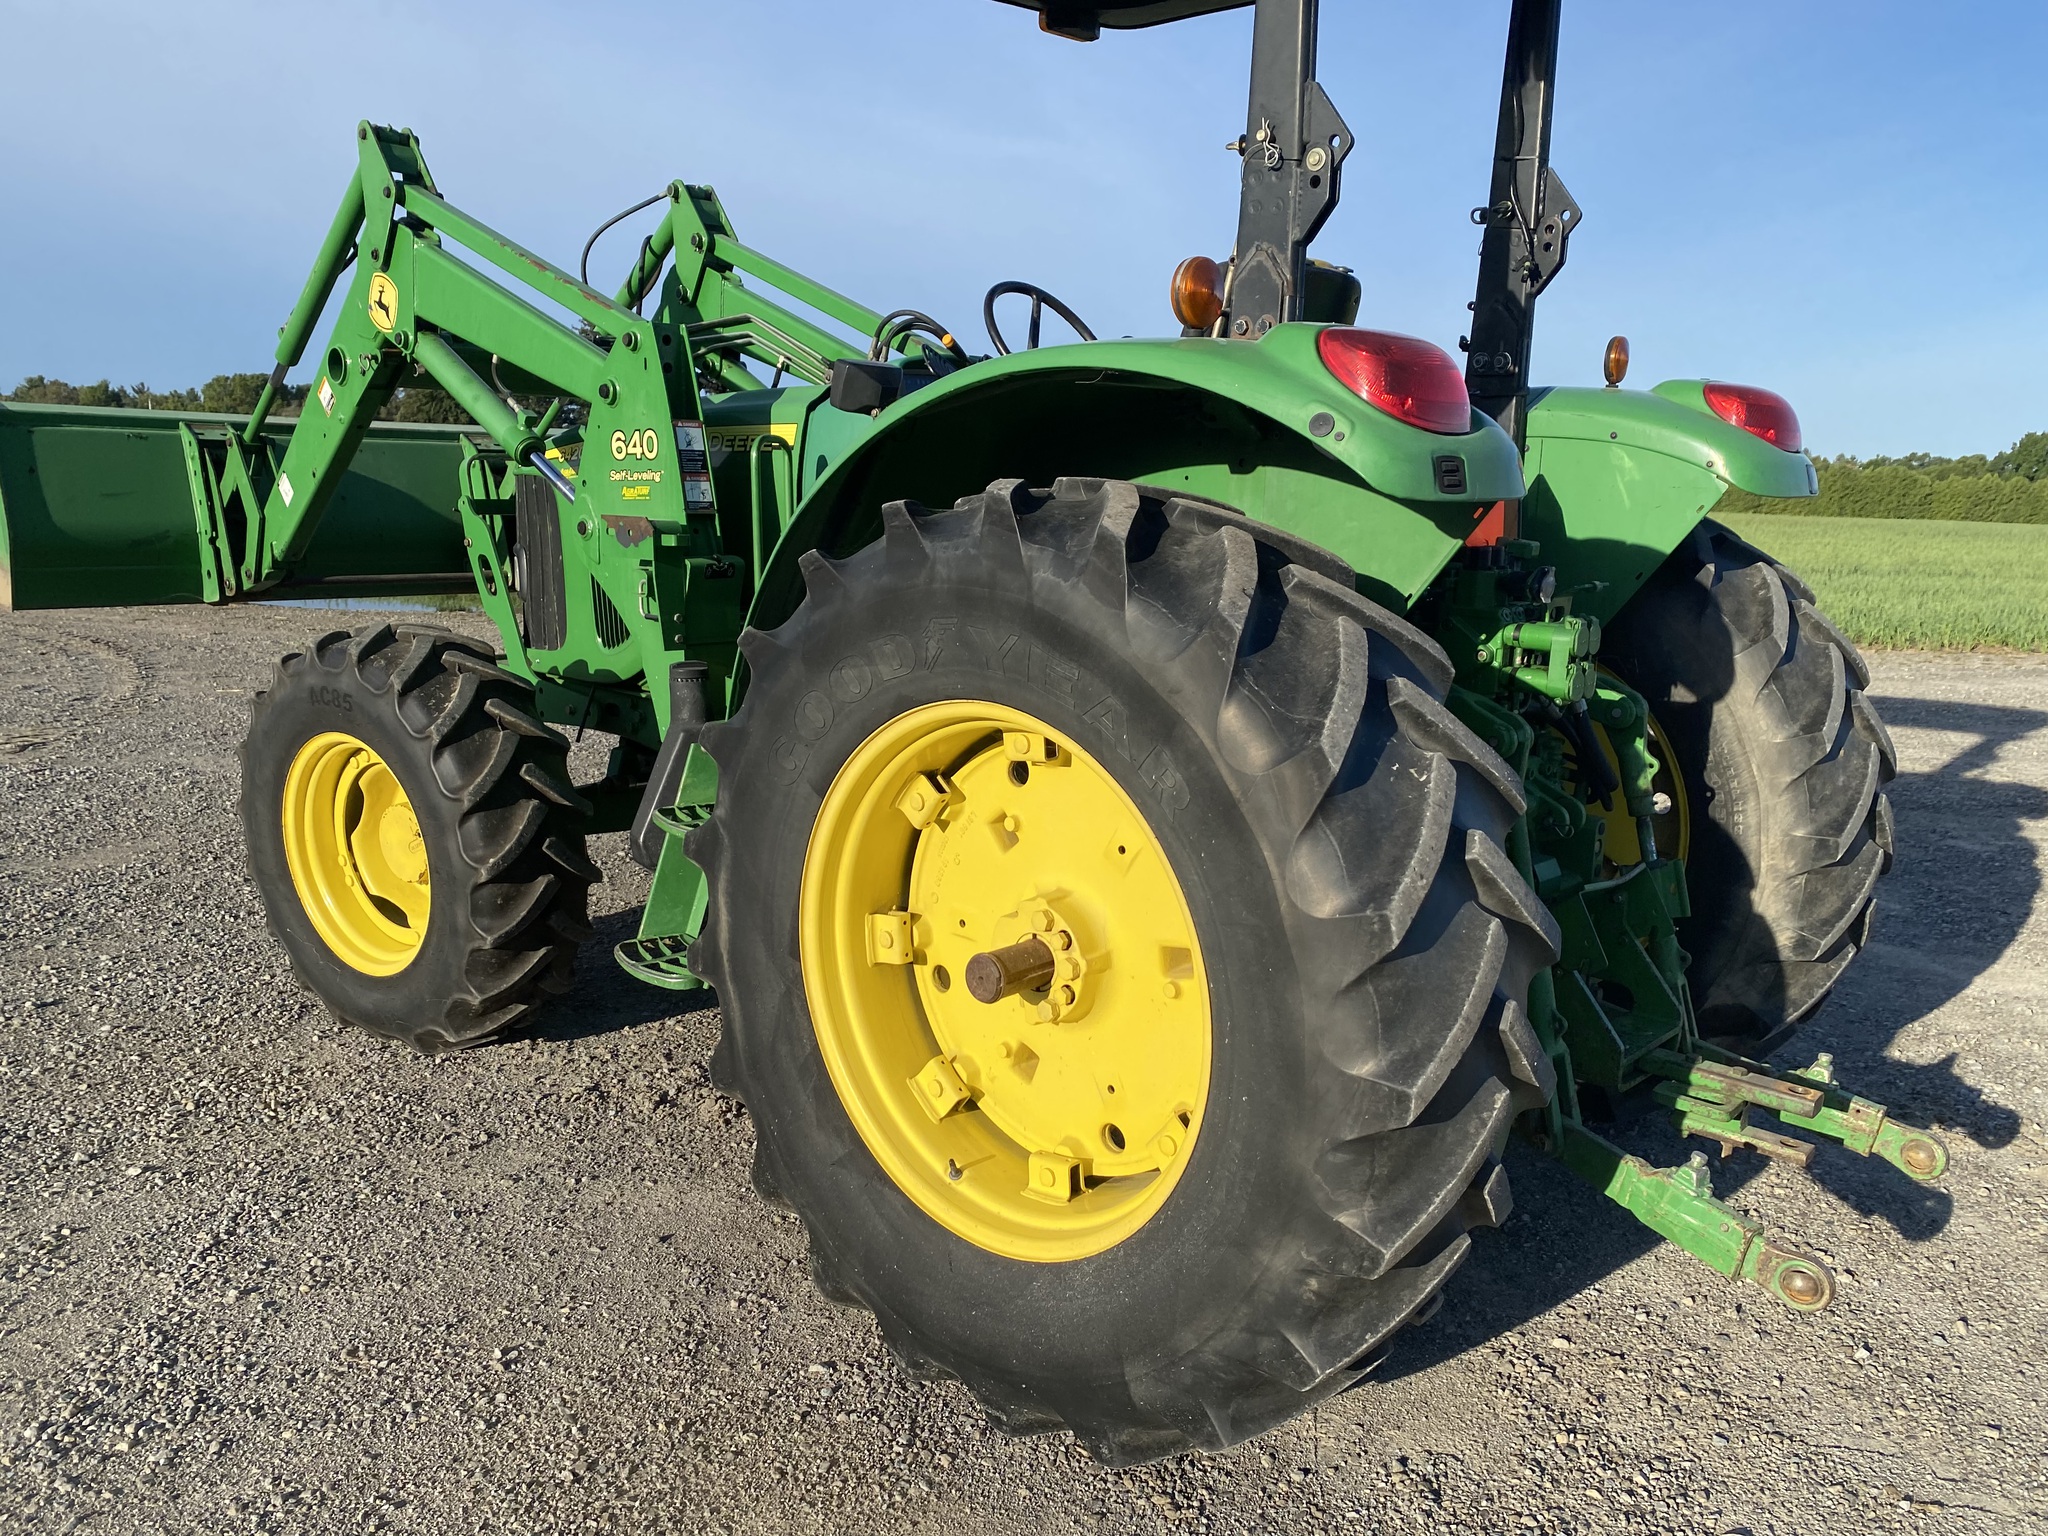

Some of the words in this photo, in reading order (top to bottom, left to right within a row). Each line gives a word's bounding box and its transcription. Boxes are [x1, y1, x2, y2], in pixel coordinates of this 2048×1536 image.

[610, 428, 659, 461] 640
[609, 469, 662, 483] Self-Leveling
[310, 686, 353, 712] AC85
[767, 616, 1191, 823] GOODYEAR
